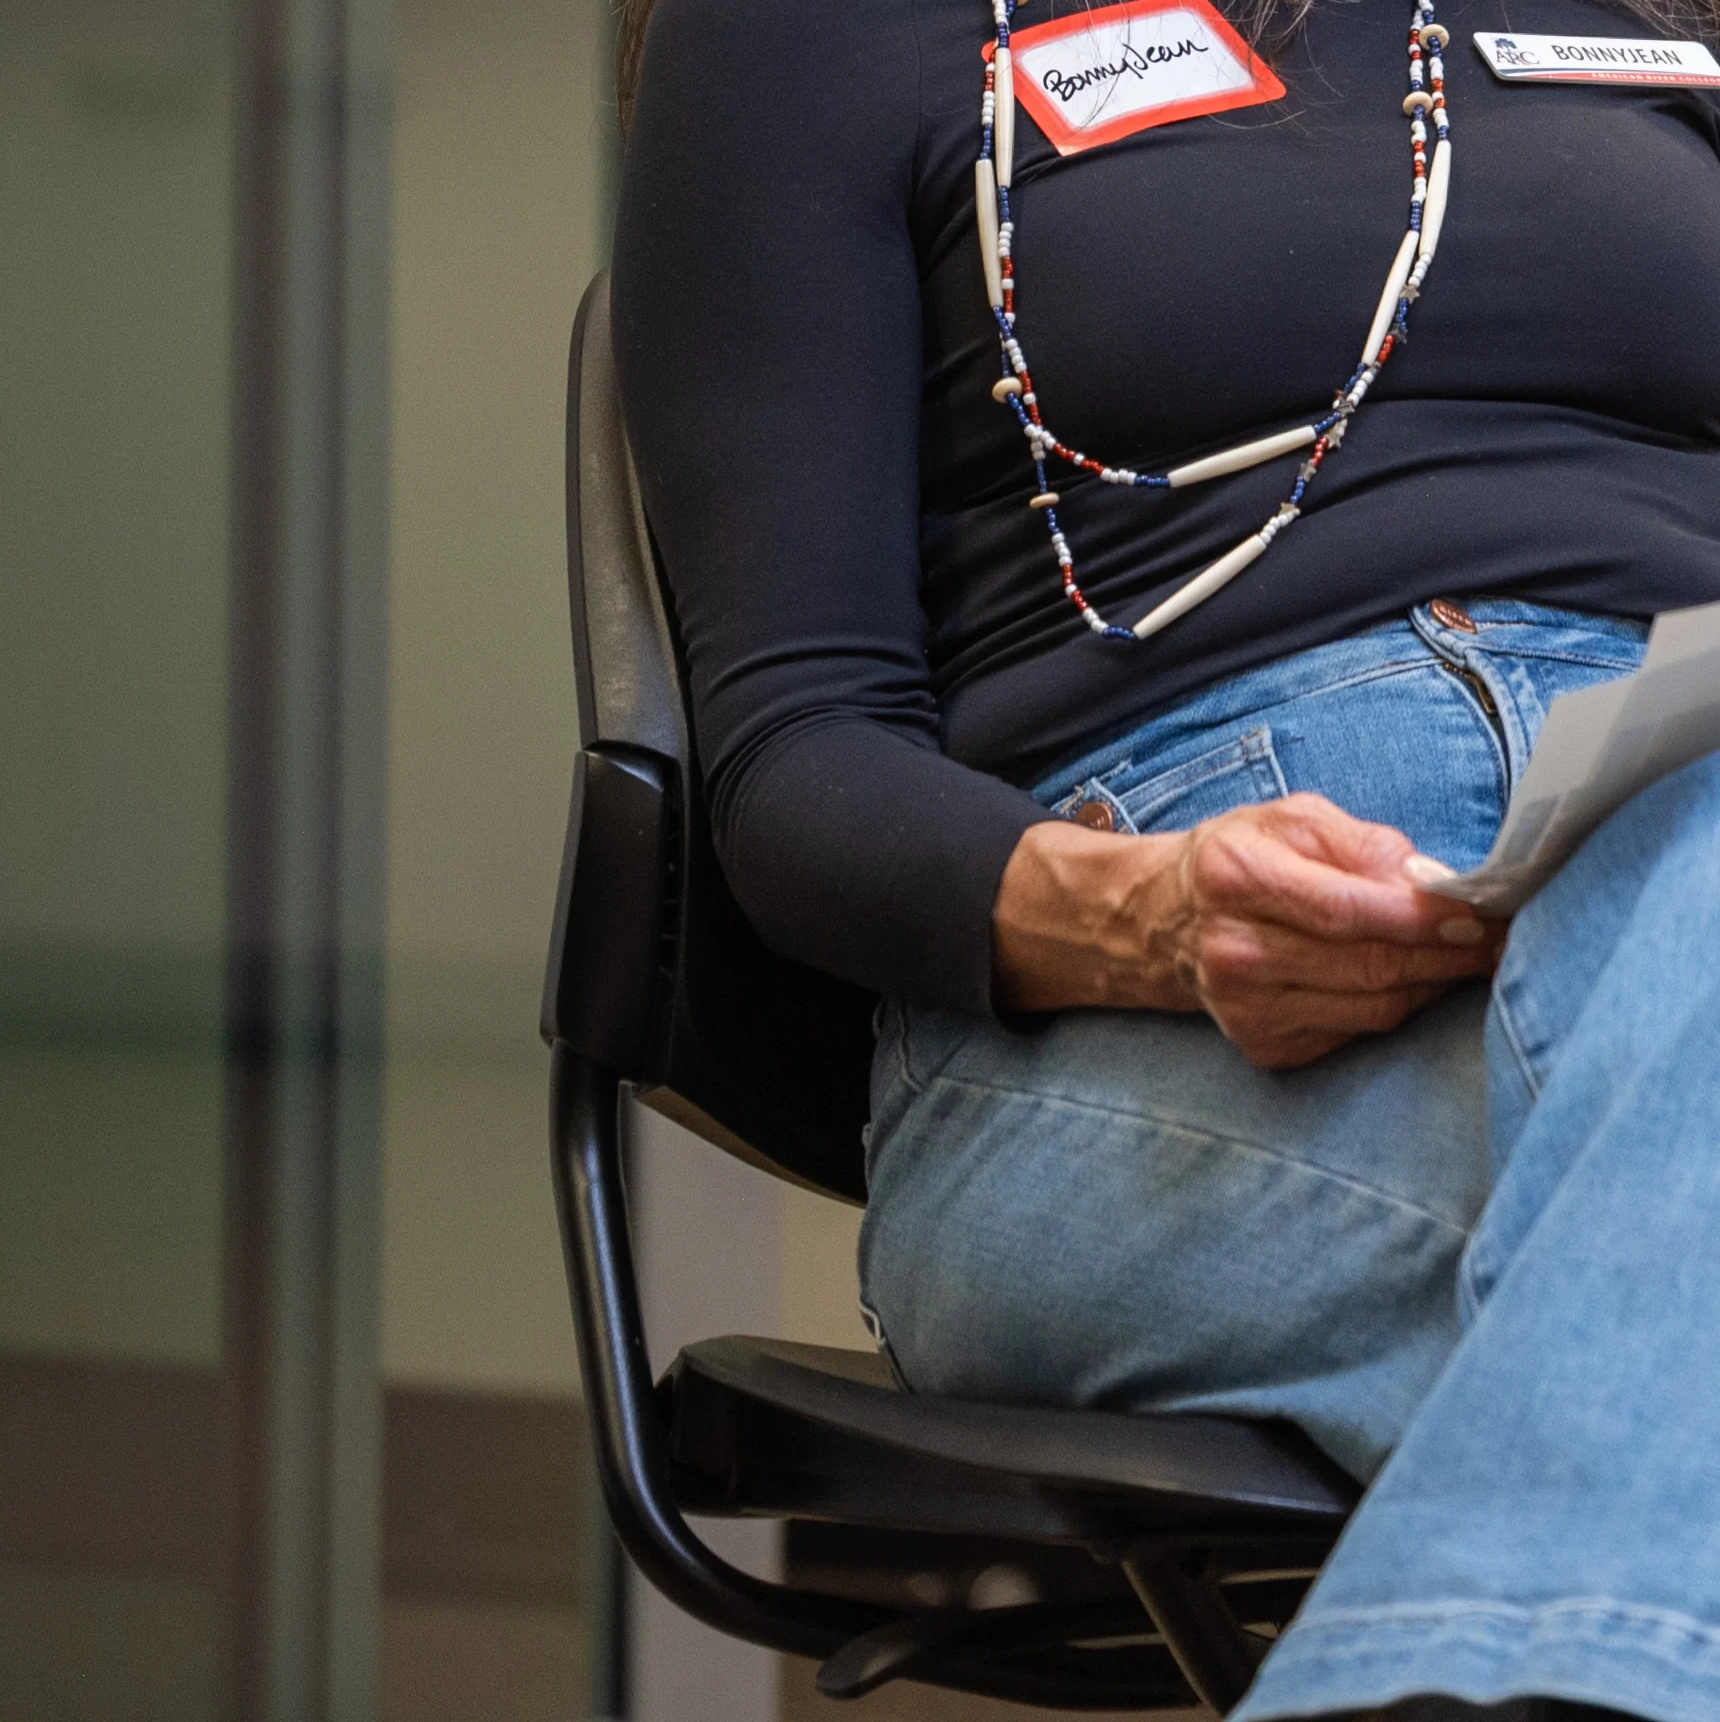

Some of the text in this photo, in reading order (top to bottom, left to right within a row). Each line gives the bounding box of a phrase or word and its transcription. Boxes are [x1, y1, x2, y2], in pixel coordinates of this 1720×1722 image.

[1495, 49, 1540, 66] ARC
[1550, 44, 1684, 66] BONNYJEAN
[1591, 72, 1643, 80] AMERICAN
